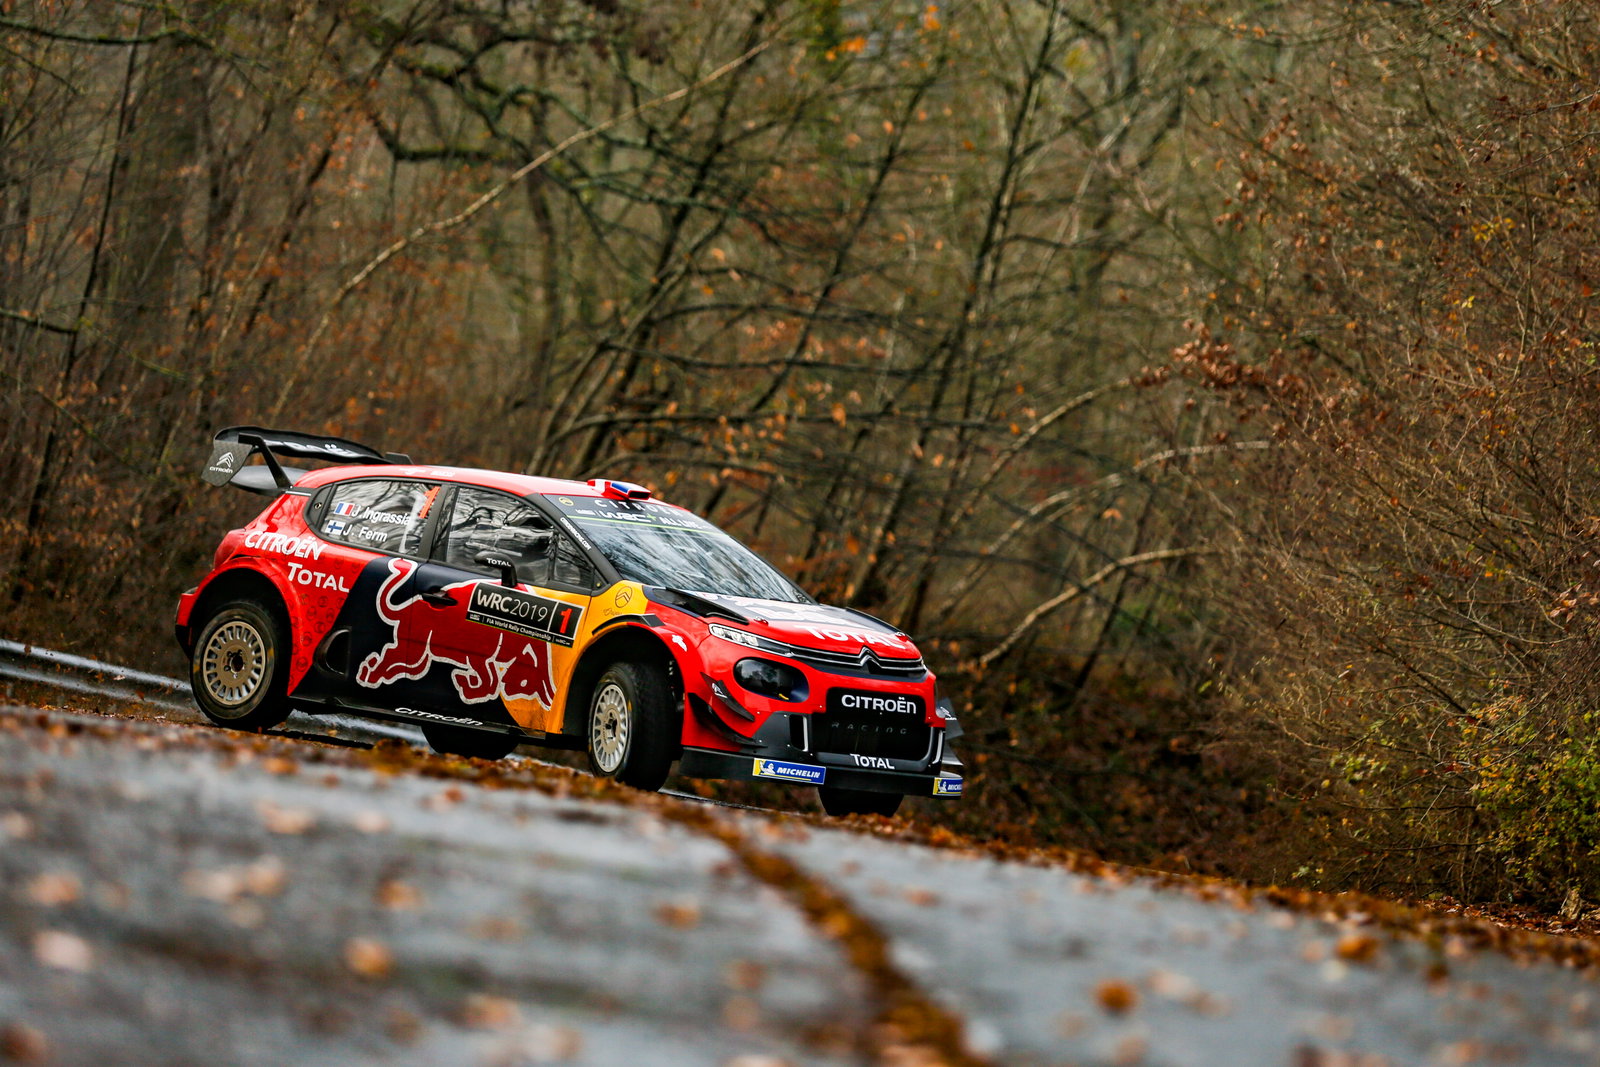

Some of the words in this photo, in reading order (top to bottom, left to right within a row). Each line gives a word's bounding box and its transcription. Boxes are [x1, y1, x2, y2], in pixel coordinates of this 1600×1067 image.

[362, 507, 411, 526] Ingrassia
[359, 526, 388, 542] Ferm
[244, 530, 328, 561] CITROËN
[486, 617, 494, 625] FIA
[494, 620, 508, 629] World
[508, 623, 520, 632] Rally
[520, 626, 552, 641] Championship
[560, 607, 573, 634] 1
[777, 766, 821, 779] MICHELIN
